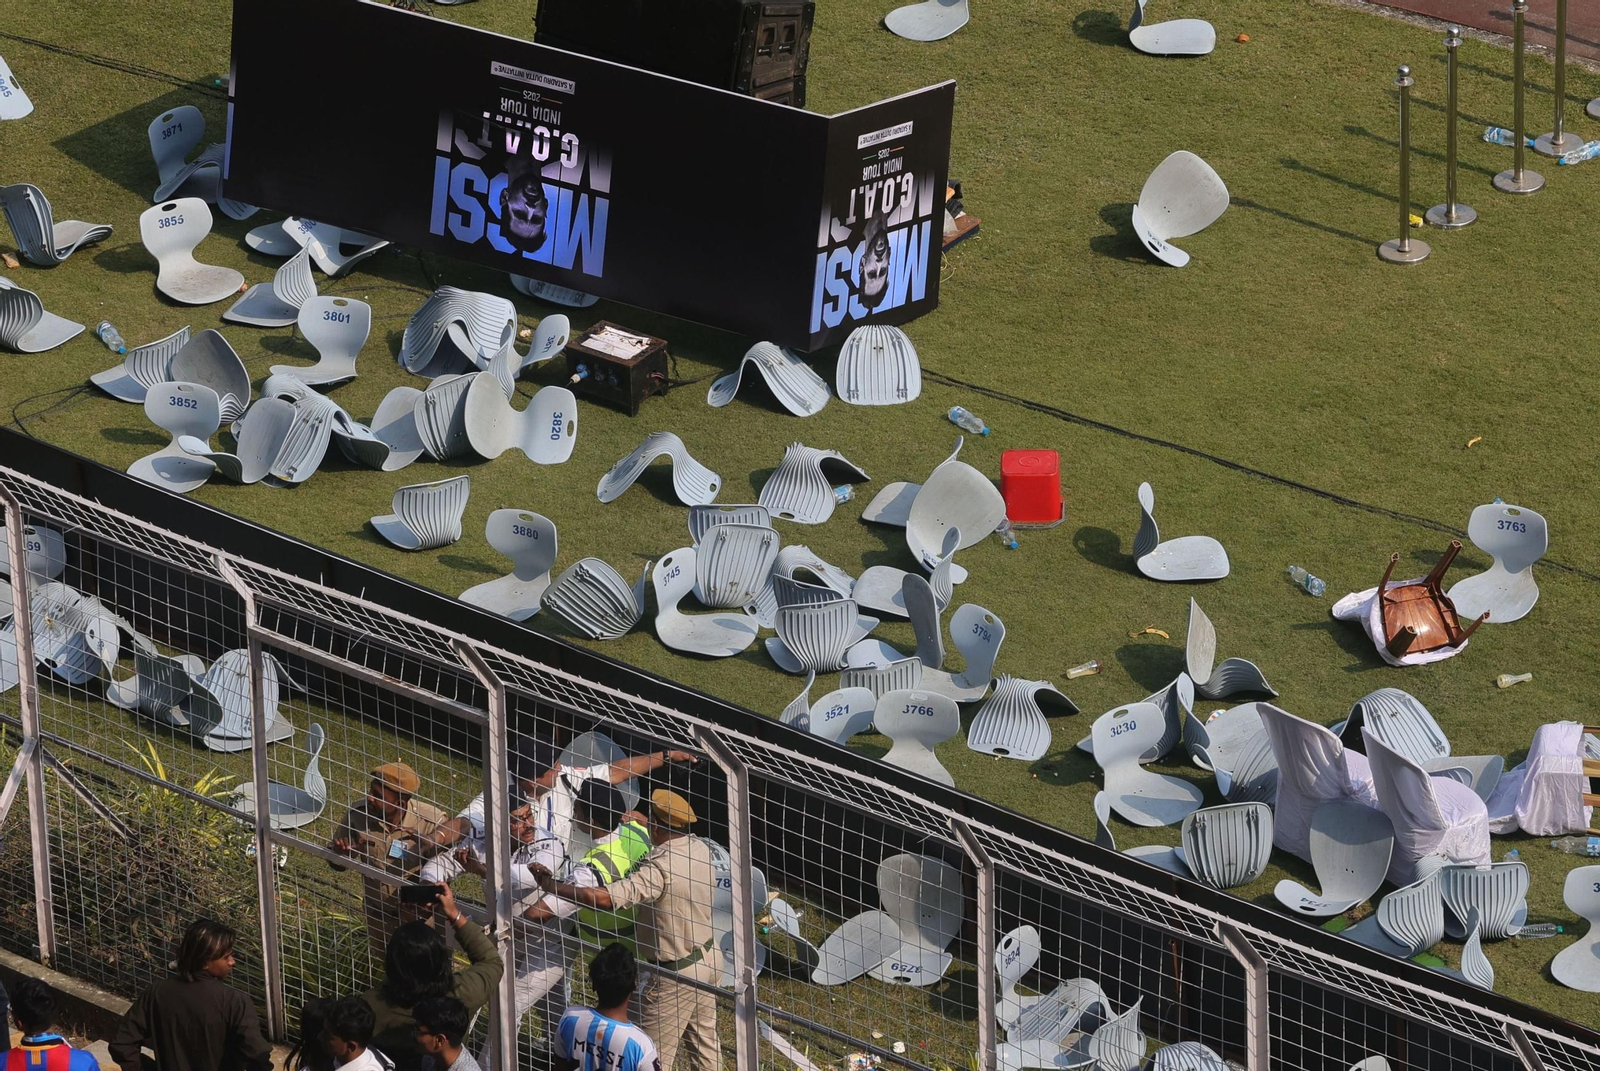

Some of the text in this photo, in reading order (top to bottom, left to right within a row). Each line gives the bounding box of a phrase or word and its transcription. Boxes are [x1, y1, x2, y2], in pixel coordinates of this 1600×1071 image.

[526, 72, 543, 82] DUTTA
[544, 77, 568, 89] SATADRU
[522, 89, 541, 102] 2025
[500, 97, 561, 125] INDIA TOUR
[162, 123, 183, 140] 3871
[878, 148, 890, 159] 2025
[862, 156, 903, 181] INDIA TOUR
[323, 310, 351, 324] 3801
[169, 396, 198, 409] 3852
[550, 411, 563, 440] 3820
[513, 525, 539, 540] 3880
[1497, 520, 1526, 533] 3763
[662, 565, 681, 587] 3745
[972, 623, 992, 644] 3794
[824, 705, 850, 722] 3521
[902, 704, 934, 717] 3766
[891, 963, 923, 974] 3759
[574, 1037, 625, 1069] MESSI
